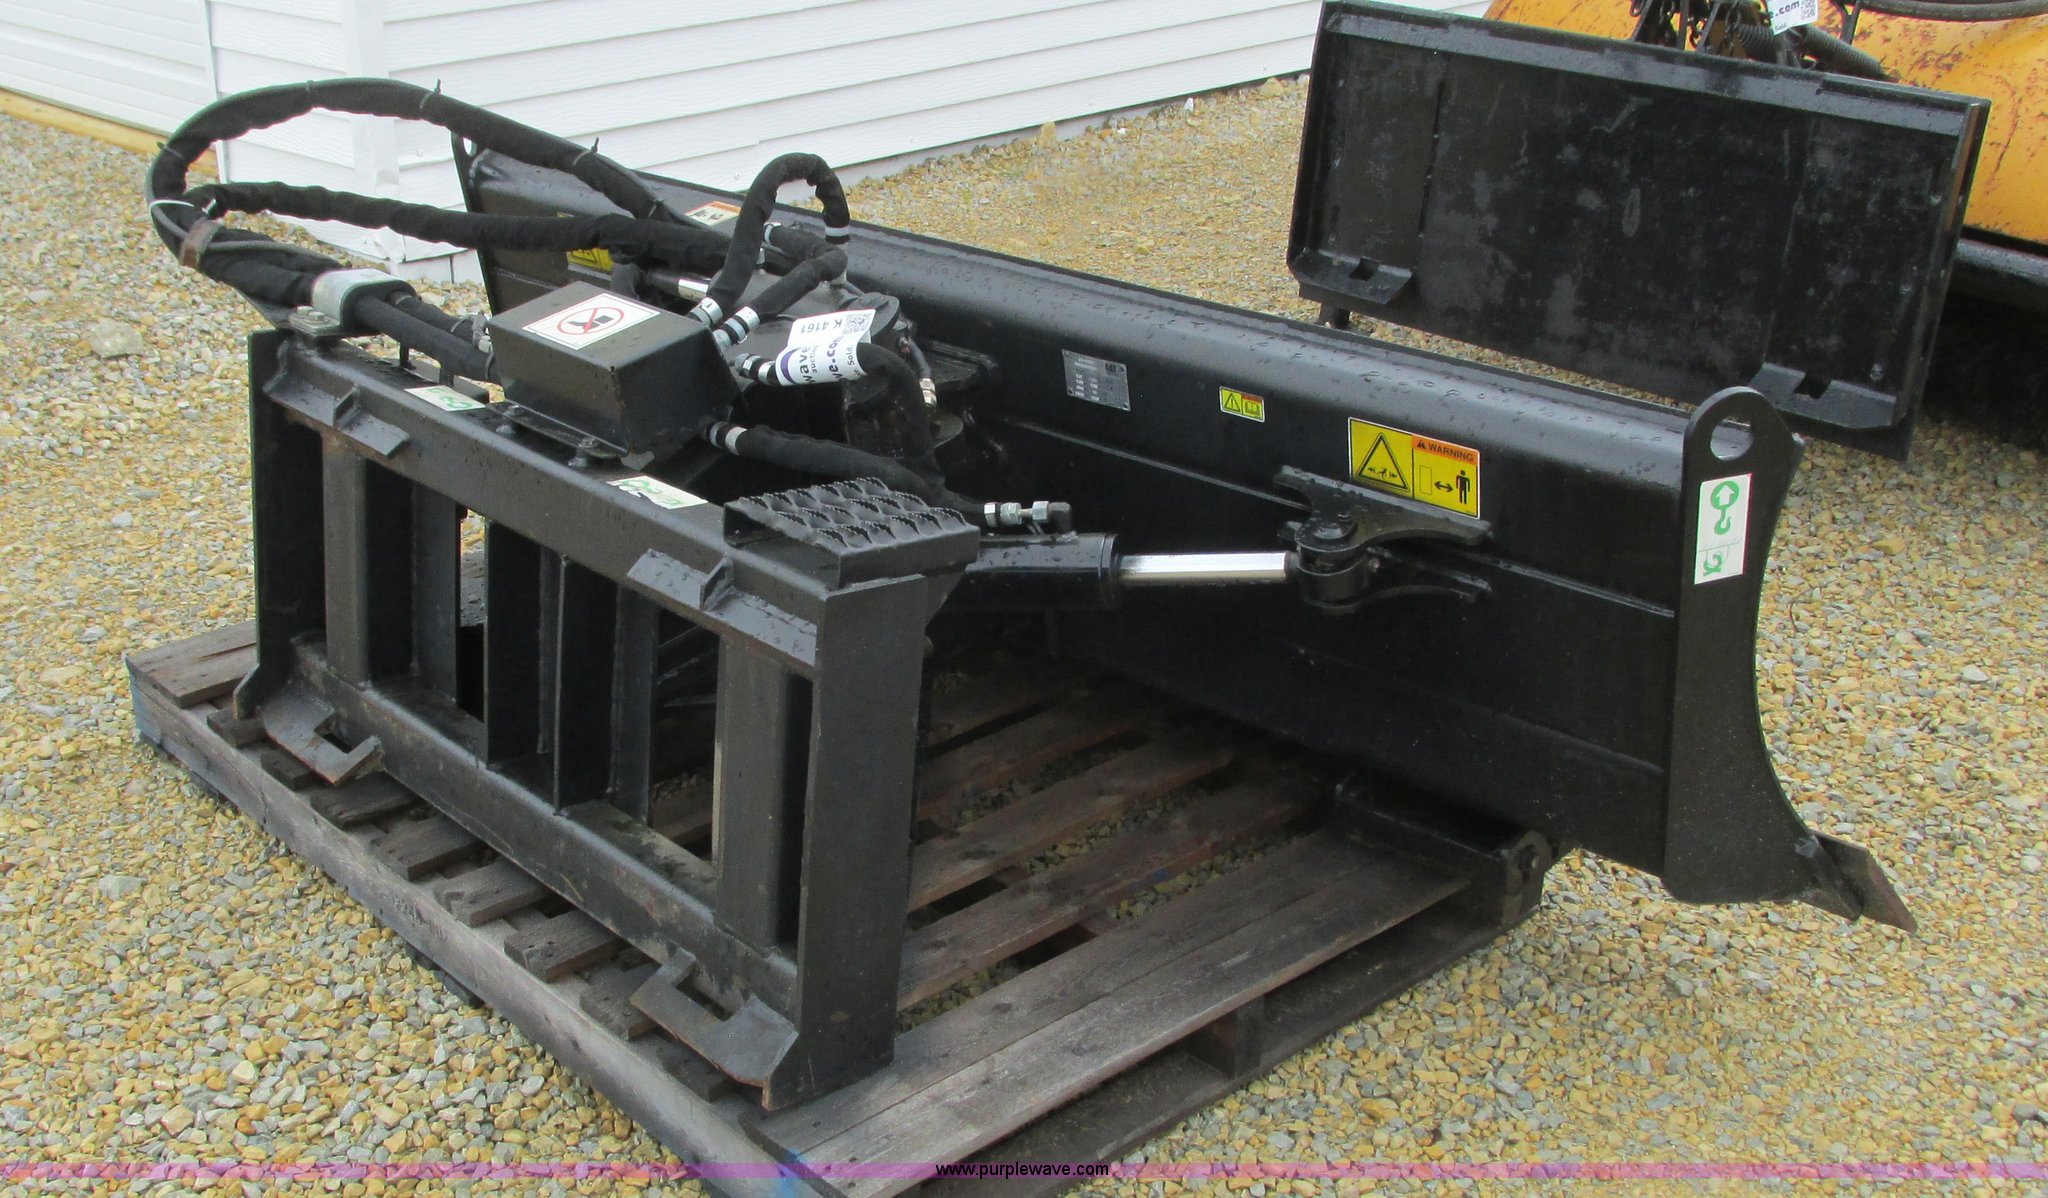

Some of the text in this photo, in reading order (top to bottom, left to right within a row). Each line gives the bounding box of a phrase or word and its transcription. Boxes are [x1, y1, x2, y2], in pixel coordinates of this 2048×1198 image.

[801, 319, 843, 334] K 4161
[1428, 443, 1474, 461] WARNING
